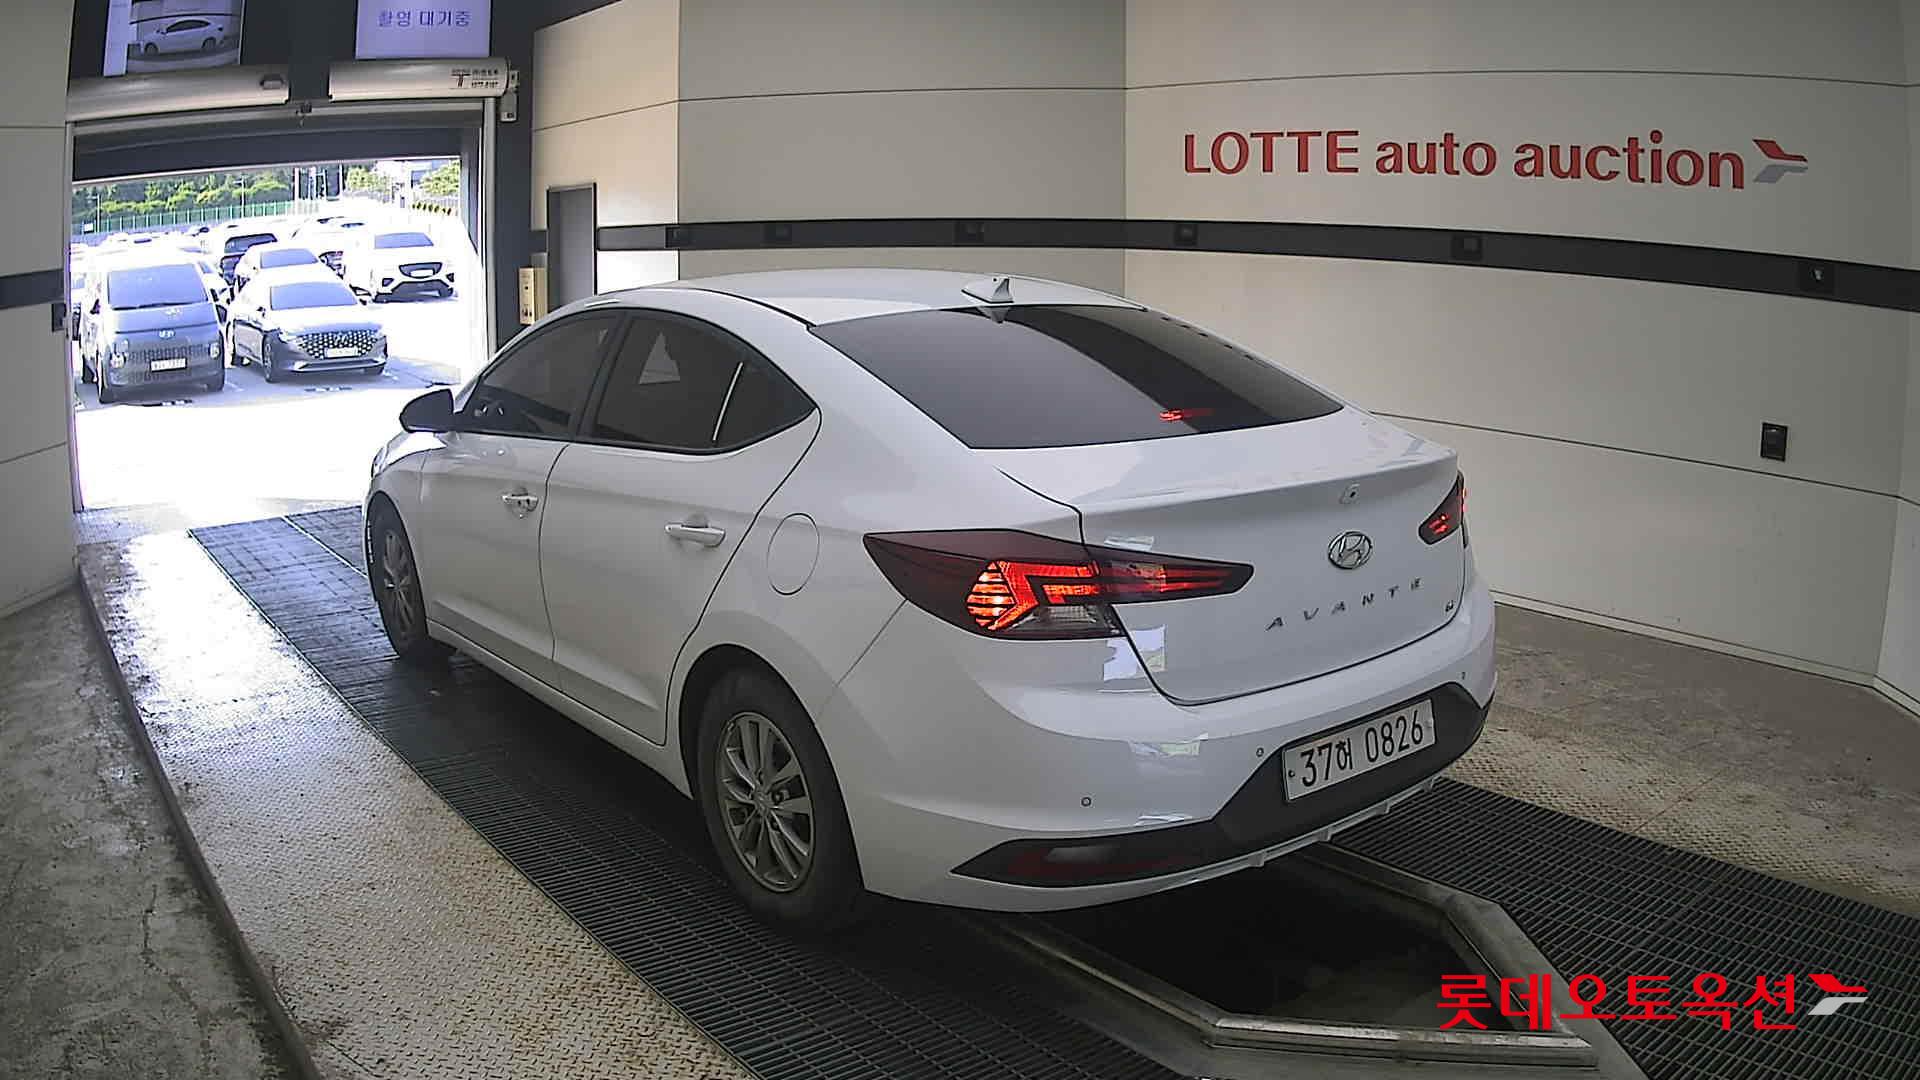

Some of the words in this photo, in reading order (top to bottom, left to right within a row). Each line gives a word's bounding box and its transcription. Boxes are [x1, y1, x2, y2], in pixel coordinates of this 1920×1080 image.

[419, 11, 469, 27] 대기중
[1185, 130, 1360, 175] LOTTE
[1376, 132, 1498, 177] auto
[1513, 130, 1746, 189] auction
[1265, 578, 1421, 631] AVANTE
[1301, 737, 1353, 787] 37허
[1364, 709, 1424, 763] 0826
